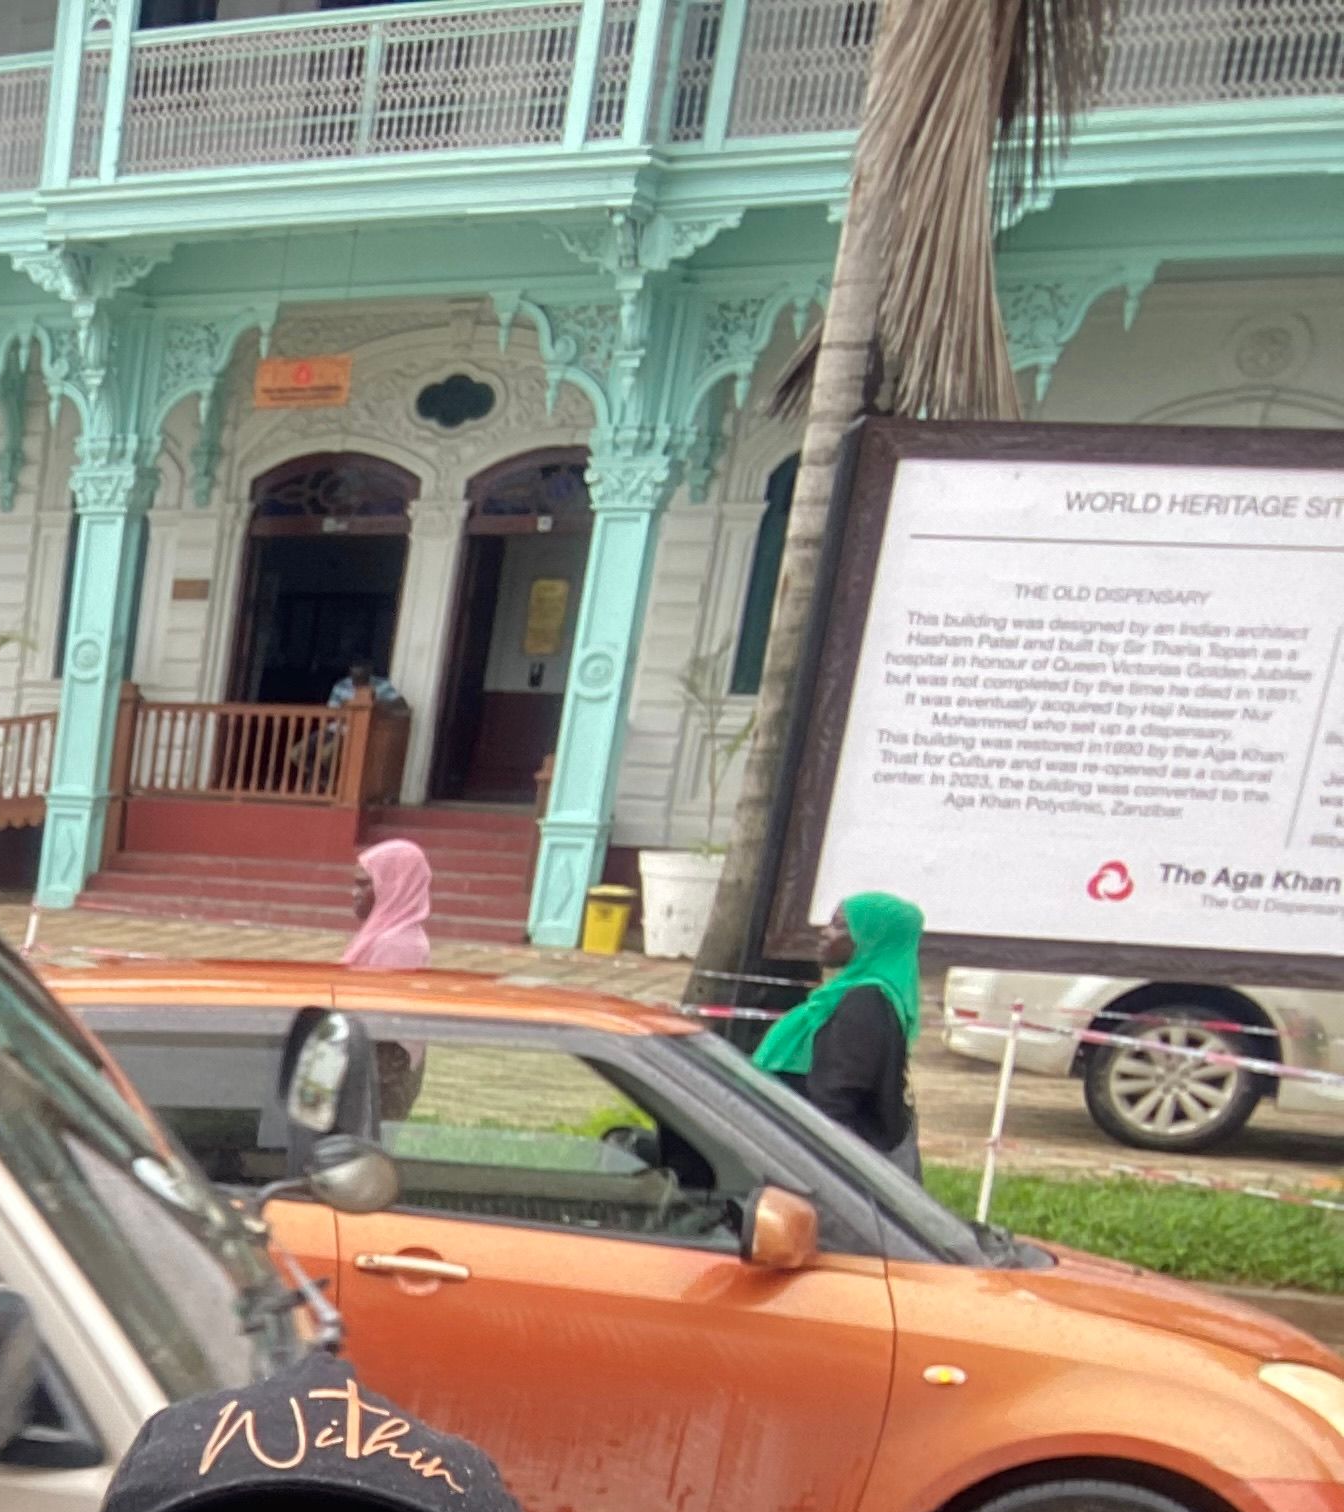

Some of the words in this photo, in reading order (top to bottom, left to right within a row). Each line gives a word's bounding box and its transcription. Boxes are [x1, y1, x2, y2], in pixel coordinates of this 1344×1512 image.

[1065, 490, 1161, 515] WORLD
[1167, 493, 1298, 518] HERITAGE
[1305, 495, 1344, 519] SIT
[1015, 585, 1048, 600] THE
[1052, 586, 1091, 601] OLD
[1095, 588, 1212, 605] DISPENSARY
[908, 612, 939, 626] This
[944, 614, 1007, 631] building
[1012, 620, 1044, 630] was
[1049, 618, 1124, 634] designed
[1129, 621, 1148, 637] by
[1154, 624, 1174, 635] an
[1179, 622, 1230, 638] Indian
[1235, 625, 1310, 640] architect
[1023, 637, 1055, 650] and
[1059, 638, 1094, 652] built
[1099, 640, 1119, 656] by
[1124, 640, 1146, 655] Sir
[1263, 648, 1282, 660] as
[1287, 650, 1297, 661] a
[885, 653, 948, 668] hospital
[952, 654, 966, 667] in
[971, 656, 1027, 670] honour
[1031, 657, 1049, 671] of
[1053, 657, 1106, 673] Queen
[1187, 663, 1247, 679] Golden
[885, 672, 912, 686] but
[916, 677, 948, 687] was
[952, 674, 979, 688] not
[983, 677, 1069, 693] completed
[1073, 680, 1093, 696] by
[1098, 681, 1124, 694] the
[1129, 682, 1164, 696] time
[1169, 684, 1189, 697] he
[1195, 685, 1232, 698] died
[1236, 686, 1251, 699] in
[905, 693, 916, 706] It
[920, 696, 952, 706] was
[956, 697, 1036, 713] eventually
[1041, 701, 1112, 716] acquired
[1117, 703, 1137, 718] by
[931, 713, 1028, 730] Mohammed
[1032, 719, 1066, 732] who
[1071, 722, 1095, 734] set
[1100, 724, 1121, 737] up
[1126, 725, 1136, 736] a
[878, 729, 908, 744] This
[914, 733, 976, 750] building
[981, 739, 1012, 750] was
[1017, 739, 1083, 753] restored
[1147, 744, 1168, 761] by
[1172, 746, 1199, 759] the
[1203, 746, 1236, 763] Aga
[1241, 749, 1284, 763] Khan
[880, 750, 918, 765] Trust
[923, 752, 944, 766] for
[949, 753, 1006, 769] Culture
[1010, 759, 1041, 771] and
[1045, 762, 1078, 773] was
[1172, 768, 1191, 779] as
[1196, 769, 1205, 780] a
[1211, 769, 1272, 783] cultural
[930, 774, 945, 786] In
[999, 777, 1025, 790] the
[1028, 779, 1092, 796] building
[1097, 784, 1129, 796] was
[1133, 786, 1217, 801] converted
[1221, 788, 1238, 802] to
[1243, 789, 1270, 803] the
[943, 793, 975, 811] Aga
[980, 794, 1021, 809] Khan
[1160, 863, 1207, 886] The
[1213, 866, 1265, 893] Aga
[1271, 869, 1342, 895] Khan
[1200, 895, 1228, 909] The
[1232, 896, 1260, 911] Old
[198, 1378, 465, 1495] Within
